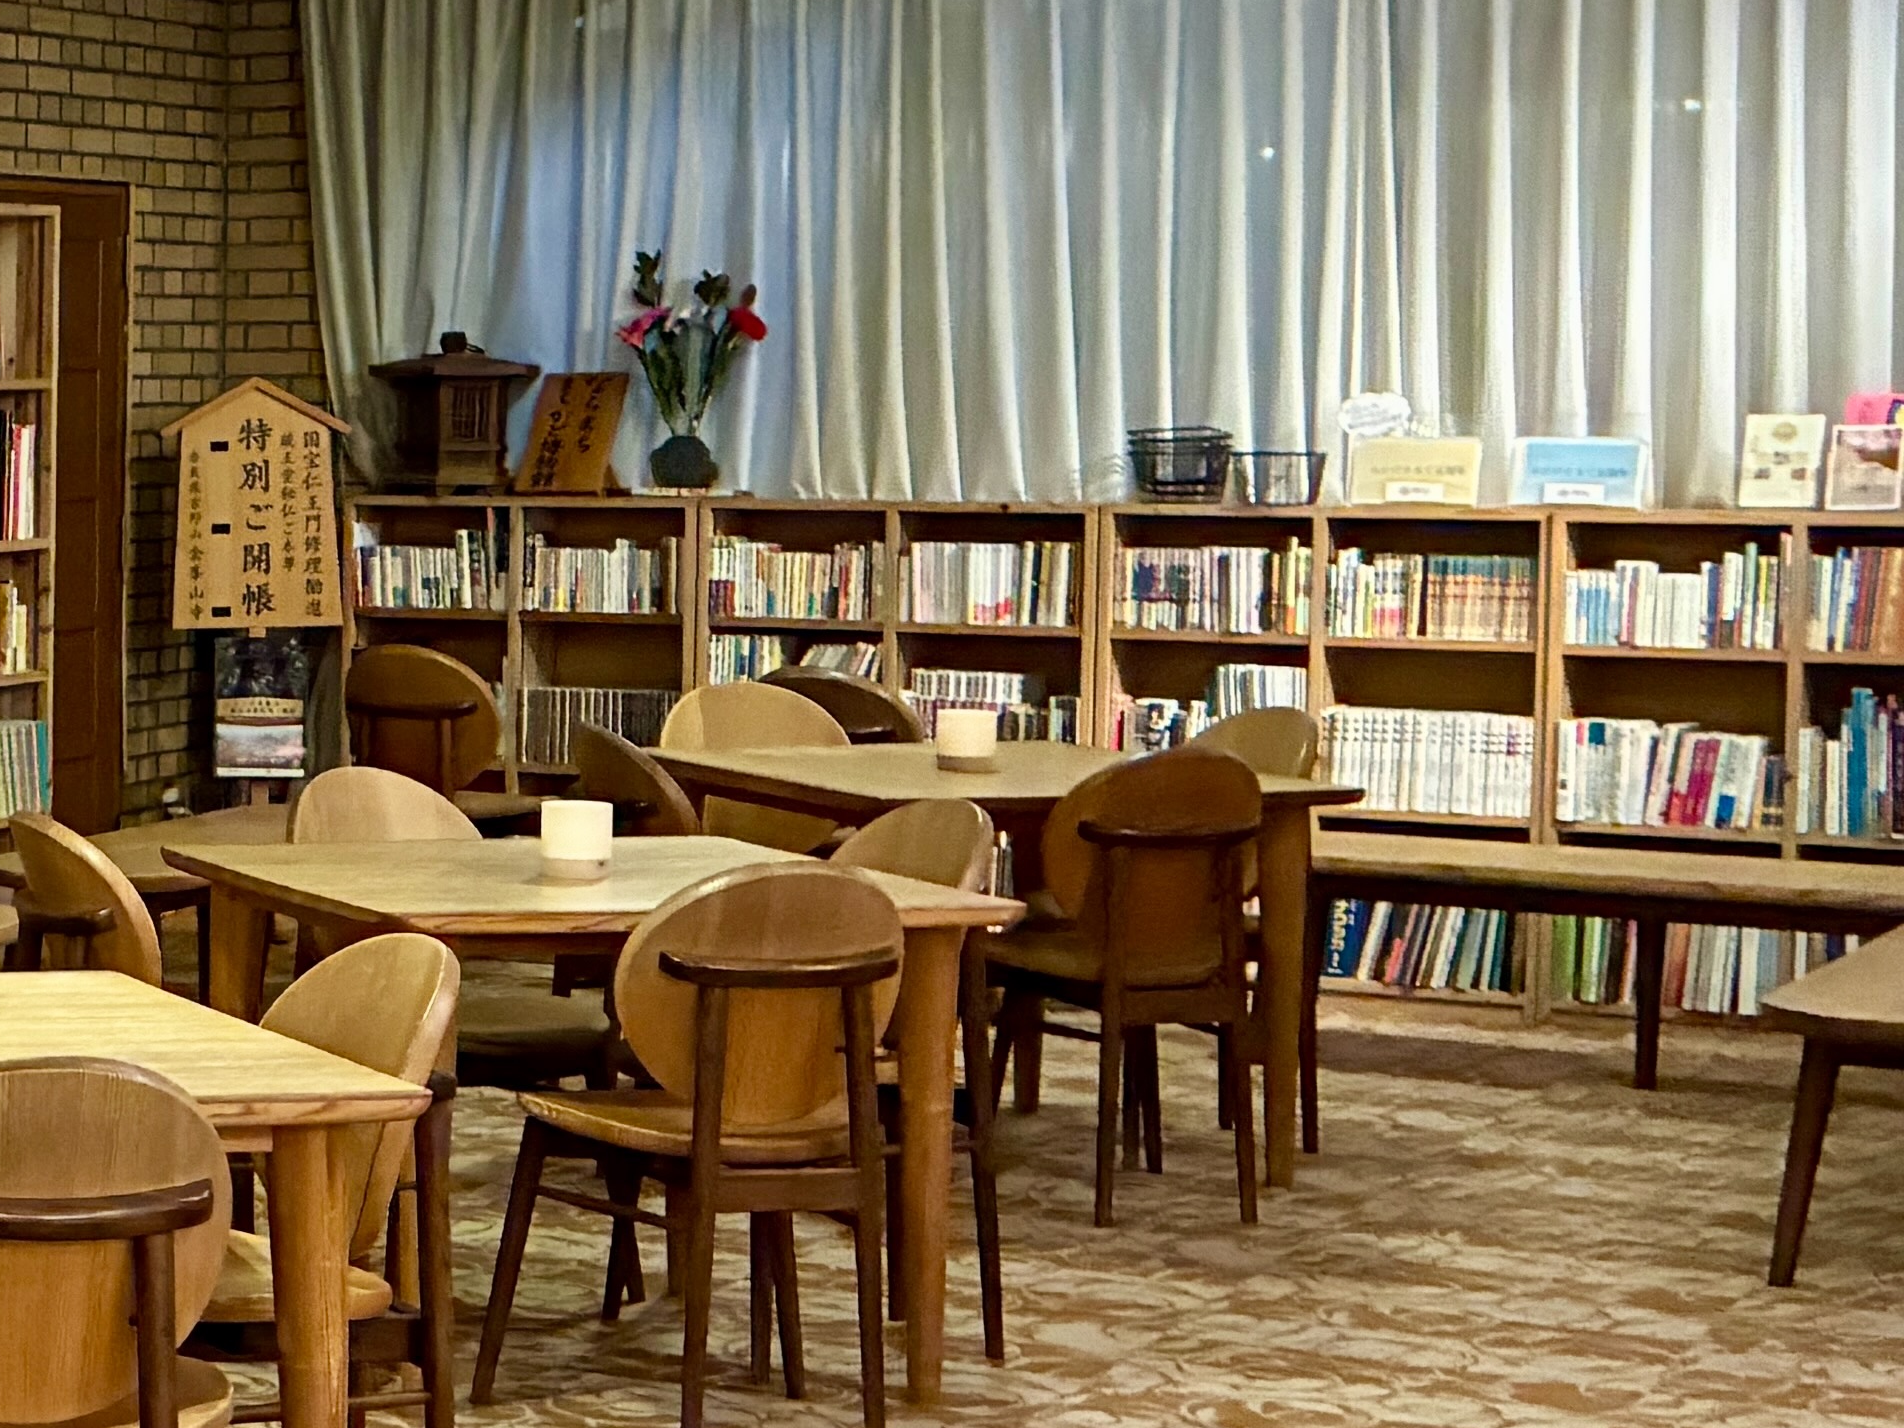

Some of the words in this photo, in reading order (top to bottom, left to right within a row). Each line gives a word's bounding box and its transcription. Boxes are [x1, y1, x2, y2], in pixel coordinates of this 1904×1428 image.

[237, 417, 275, 617] 特別ご開帳
